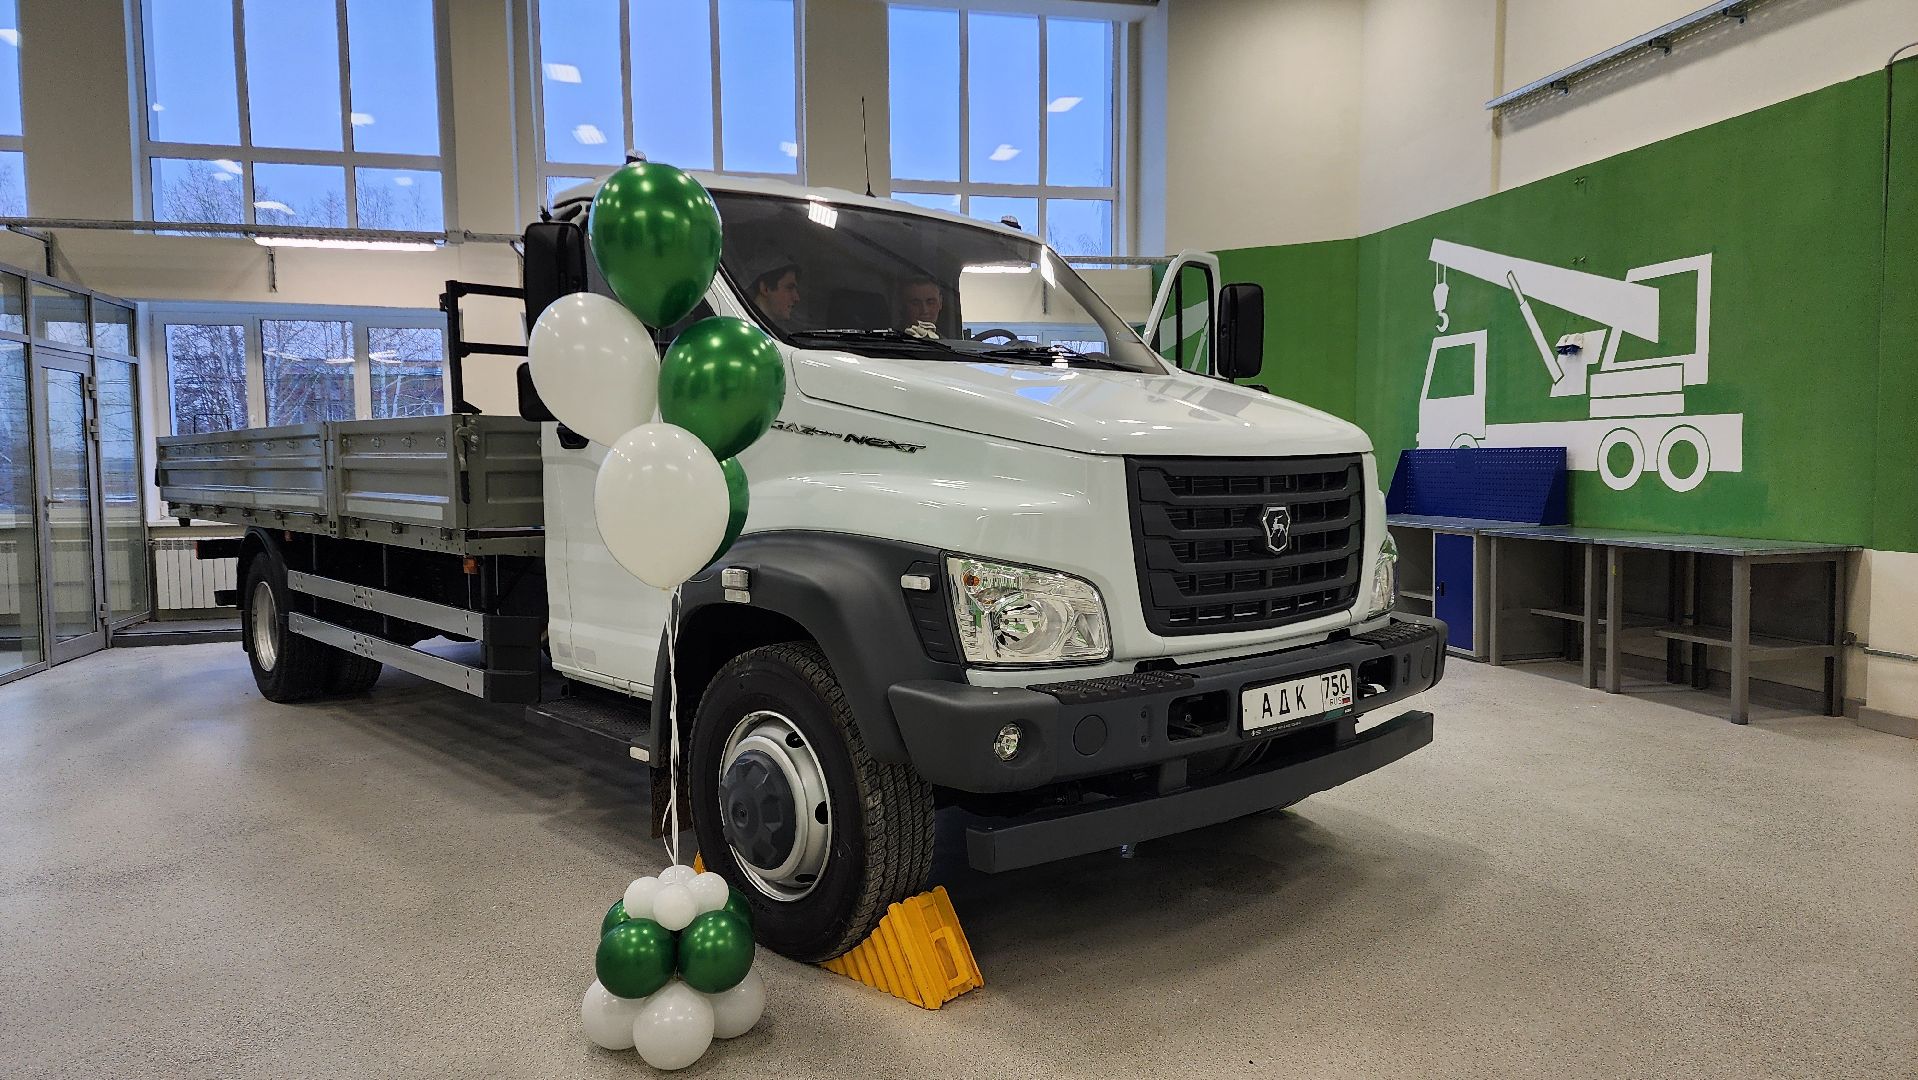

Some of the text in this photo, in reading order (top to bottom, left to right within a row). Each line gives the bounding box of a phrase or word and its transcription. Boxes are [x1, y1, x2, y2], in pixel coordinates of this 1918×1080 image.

[843, 433, 927, 453] NEXT
[1321, 673, 1349, 699] 750
[1329, 696, 1342, 706] RUS
